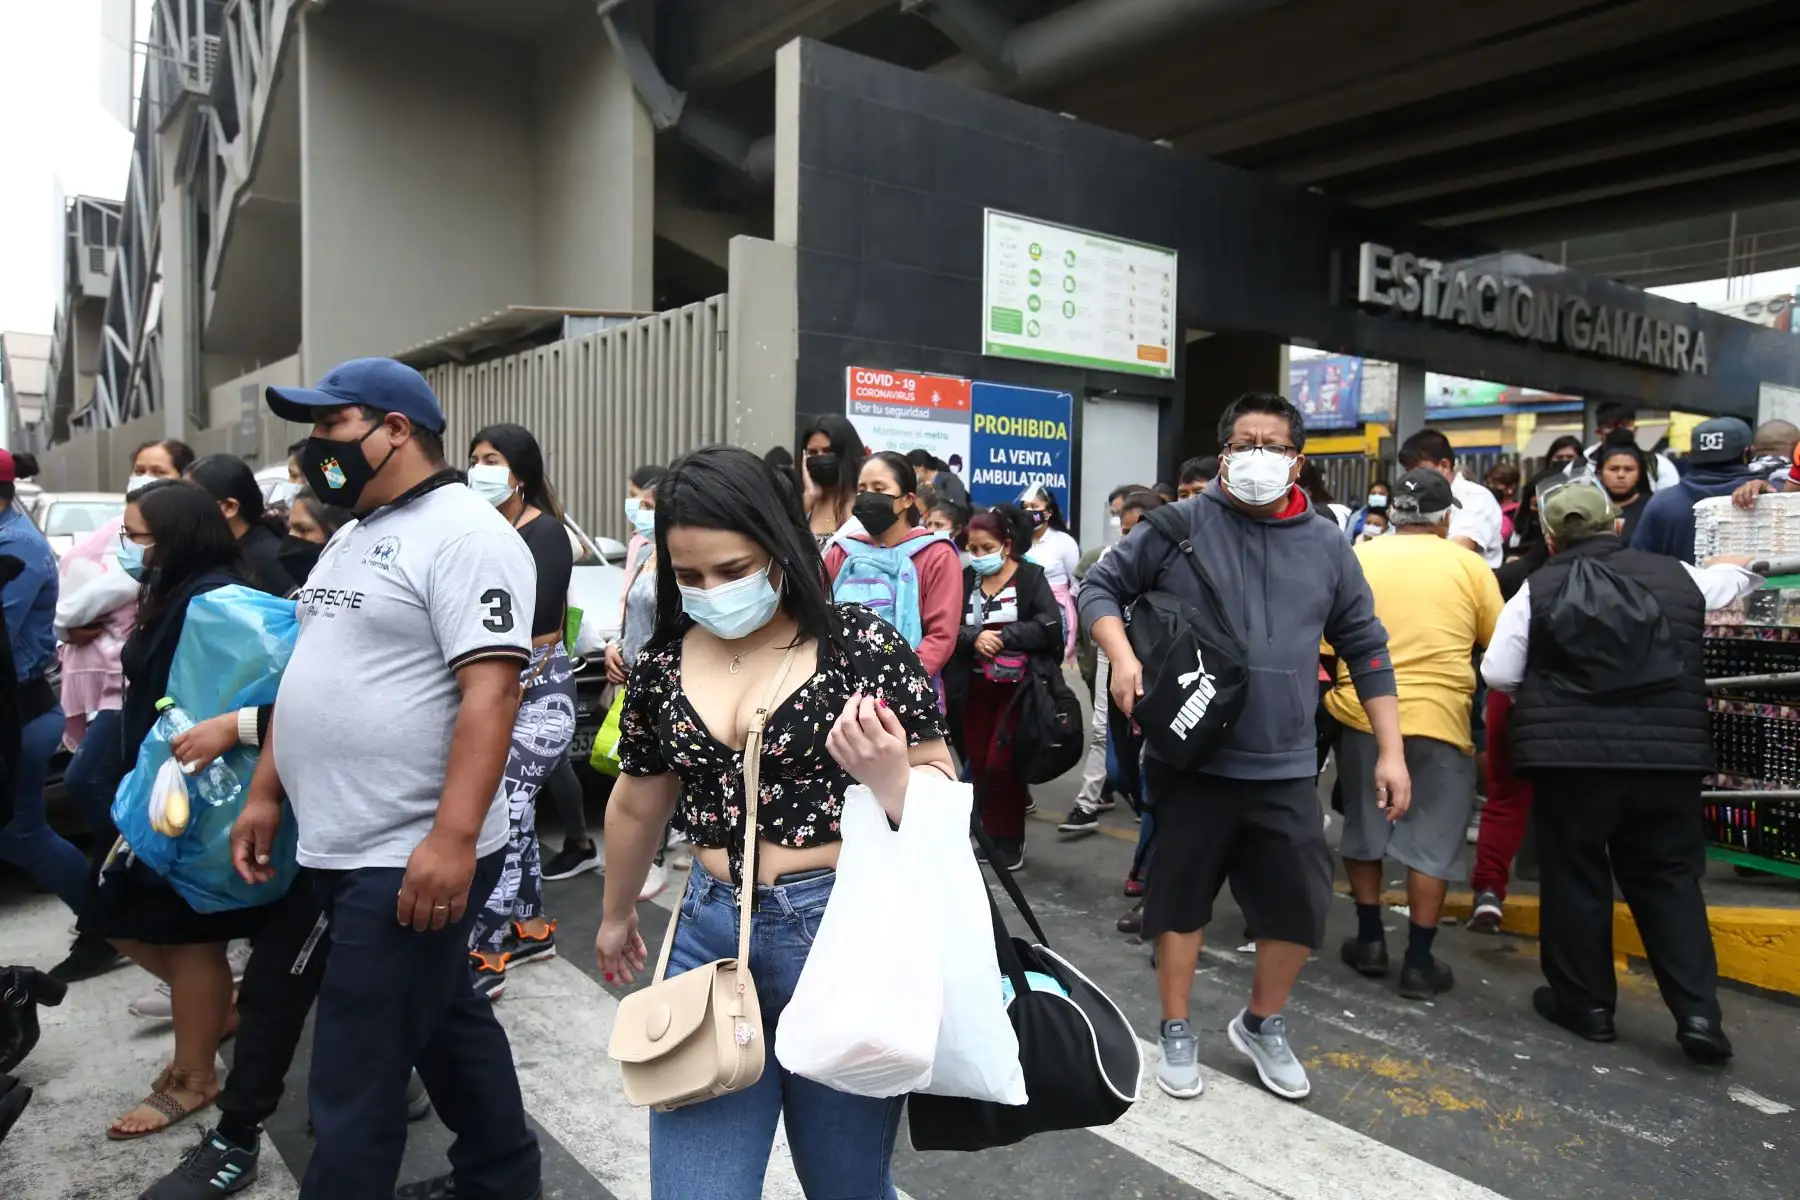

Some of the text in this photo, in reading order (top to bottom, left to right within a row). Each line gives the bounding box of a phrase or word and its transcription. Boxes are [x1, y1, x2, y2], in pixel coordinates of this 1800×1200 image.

[1568, 297, 1708, 375] GAMARRA
[856, 371, 893, 387] COVID
[902, 378, 916, 391] 19
[855, 387, 916, 401] CORONAVIRUS
[855, 402, 930, 418] Por tu seguridad
[924, 431, 949, 440] metro
[974, 413, 1067, 440] PROHIBIDA
[990, 447, 1052, 466] LA VENTA
[972, 468, 1066, 488] AMBULATORIA
[480, 588, 514, 633] 3
[1169, 675, 1216, 741] PUMA
